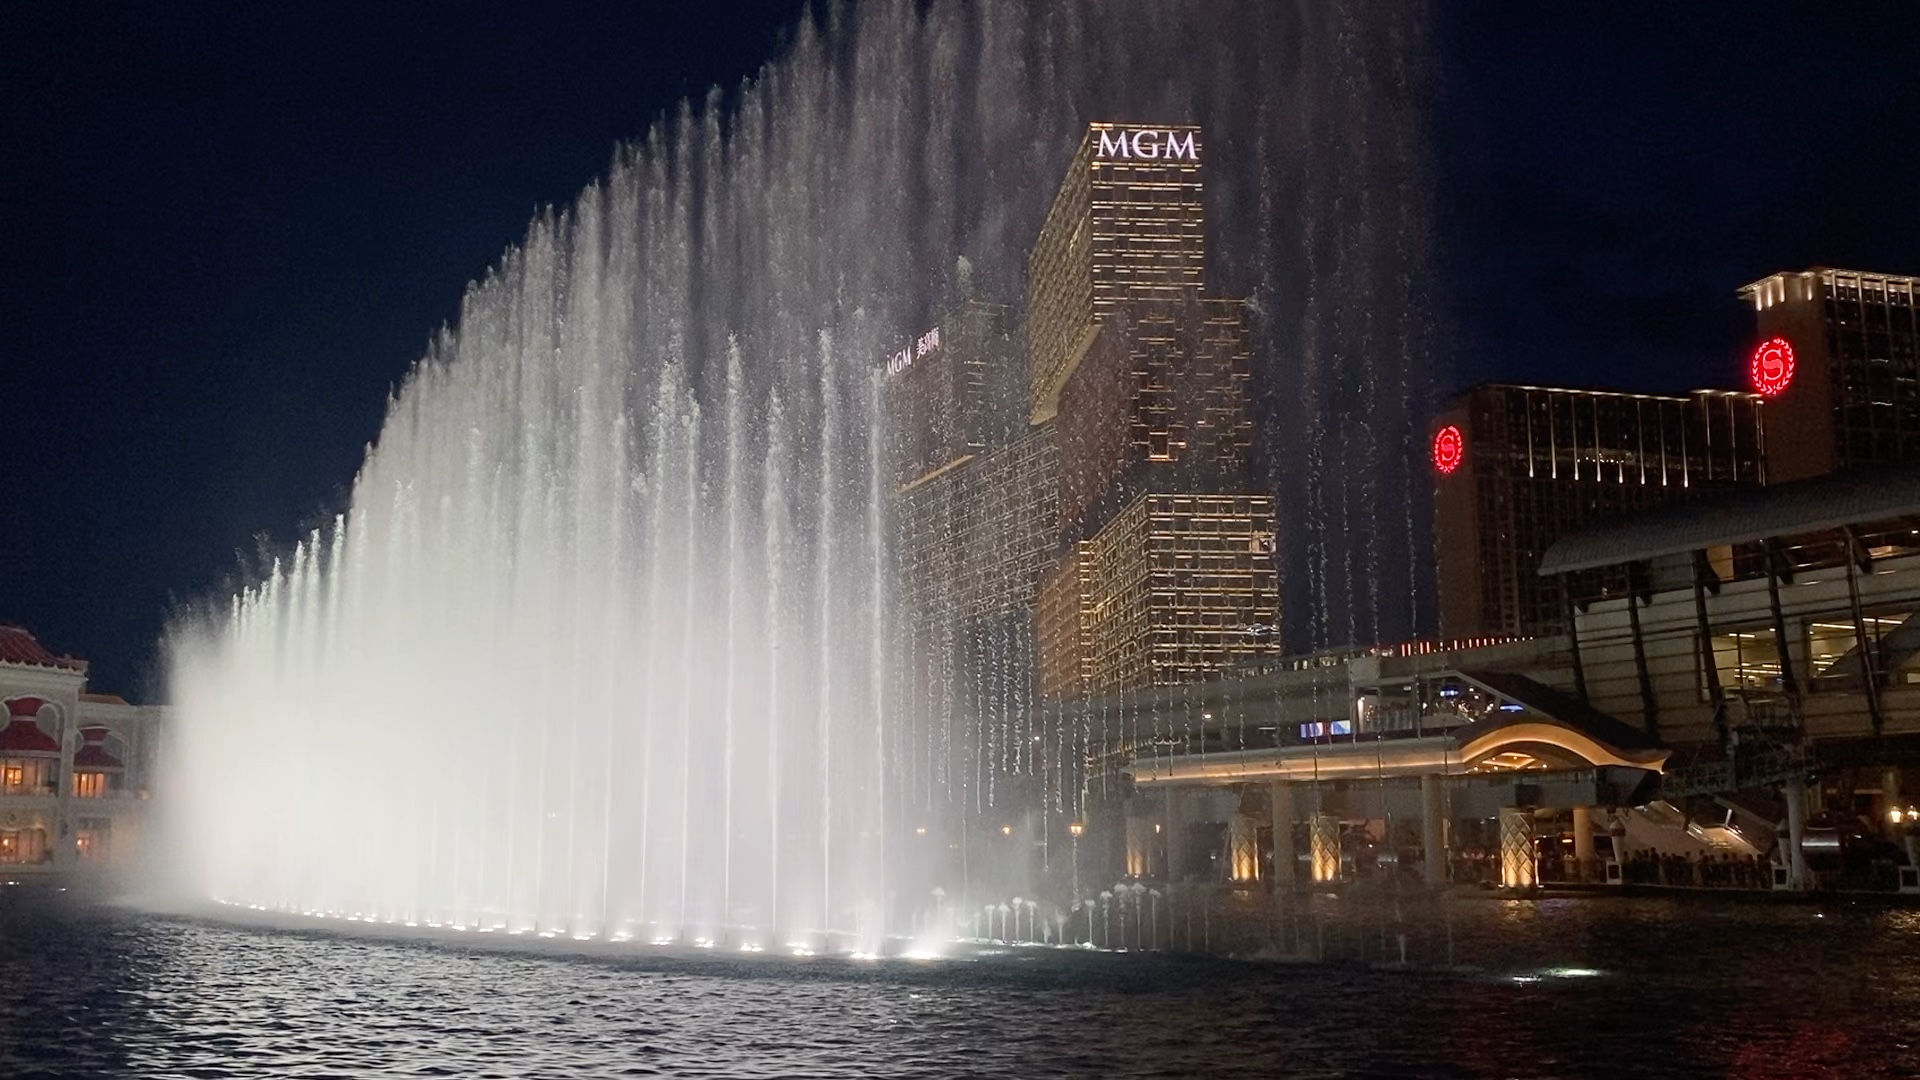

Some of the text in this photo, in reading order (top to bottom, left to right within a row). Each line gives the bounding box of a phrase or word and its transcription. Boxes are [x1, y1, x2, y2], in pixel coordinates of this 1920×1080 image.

[1096, 129, 1199, 159] MGM
[1762, 347, 1784, 381] S
[1440, 433, 1456, 462] S
